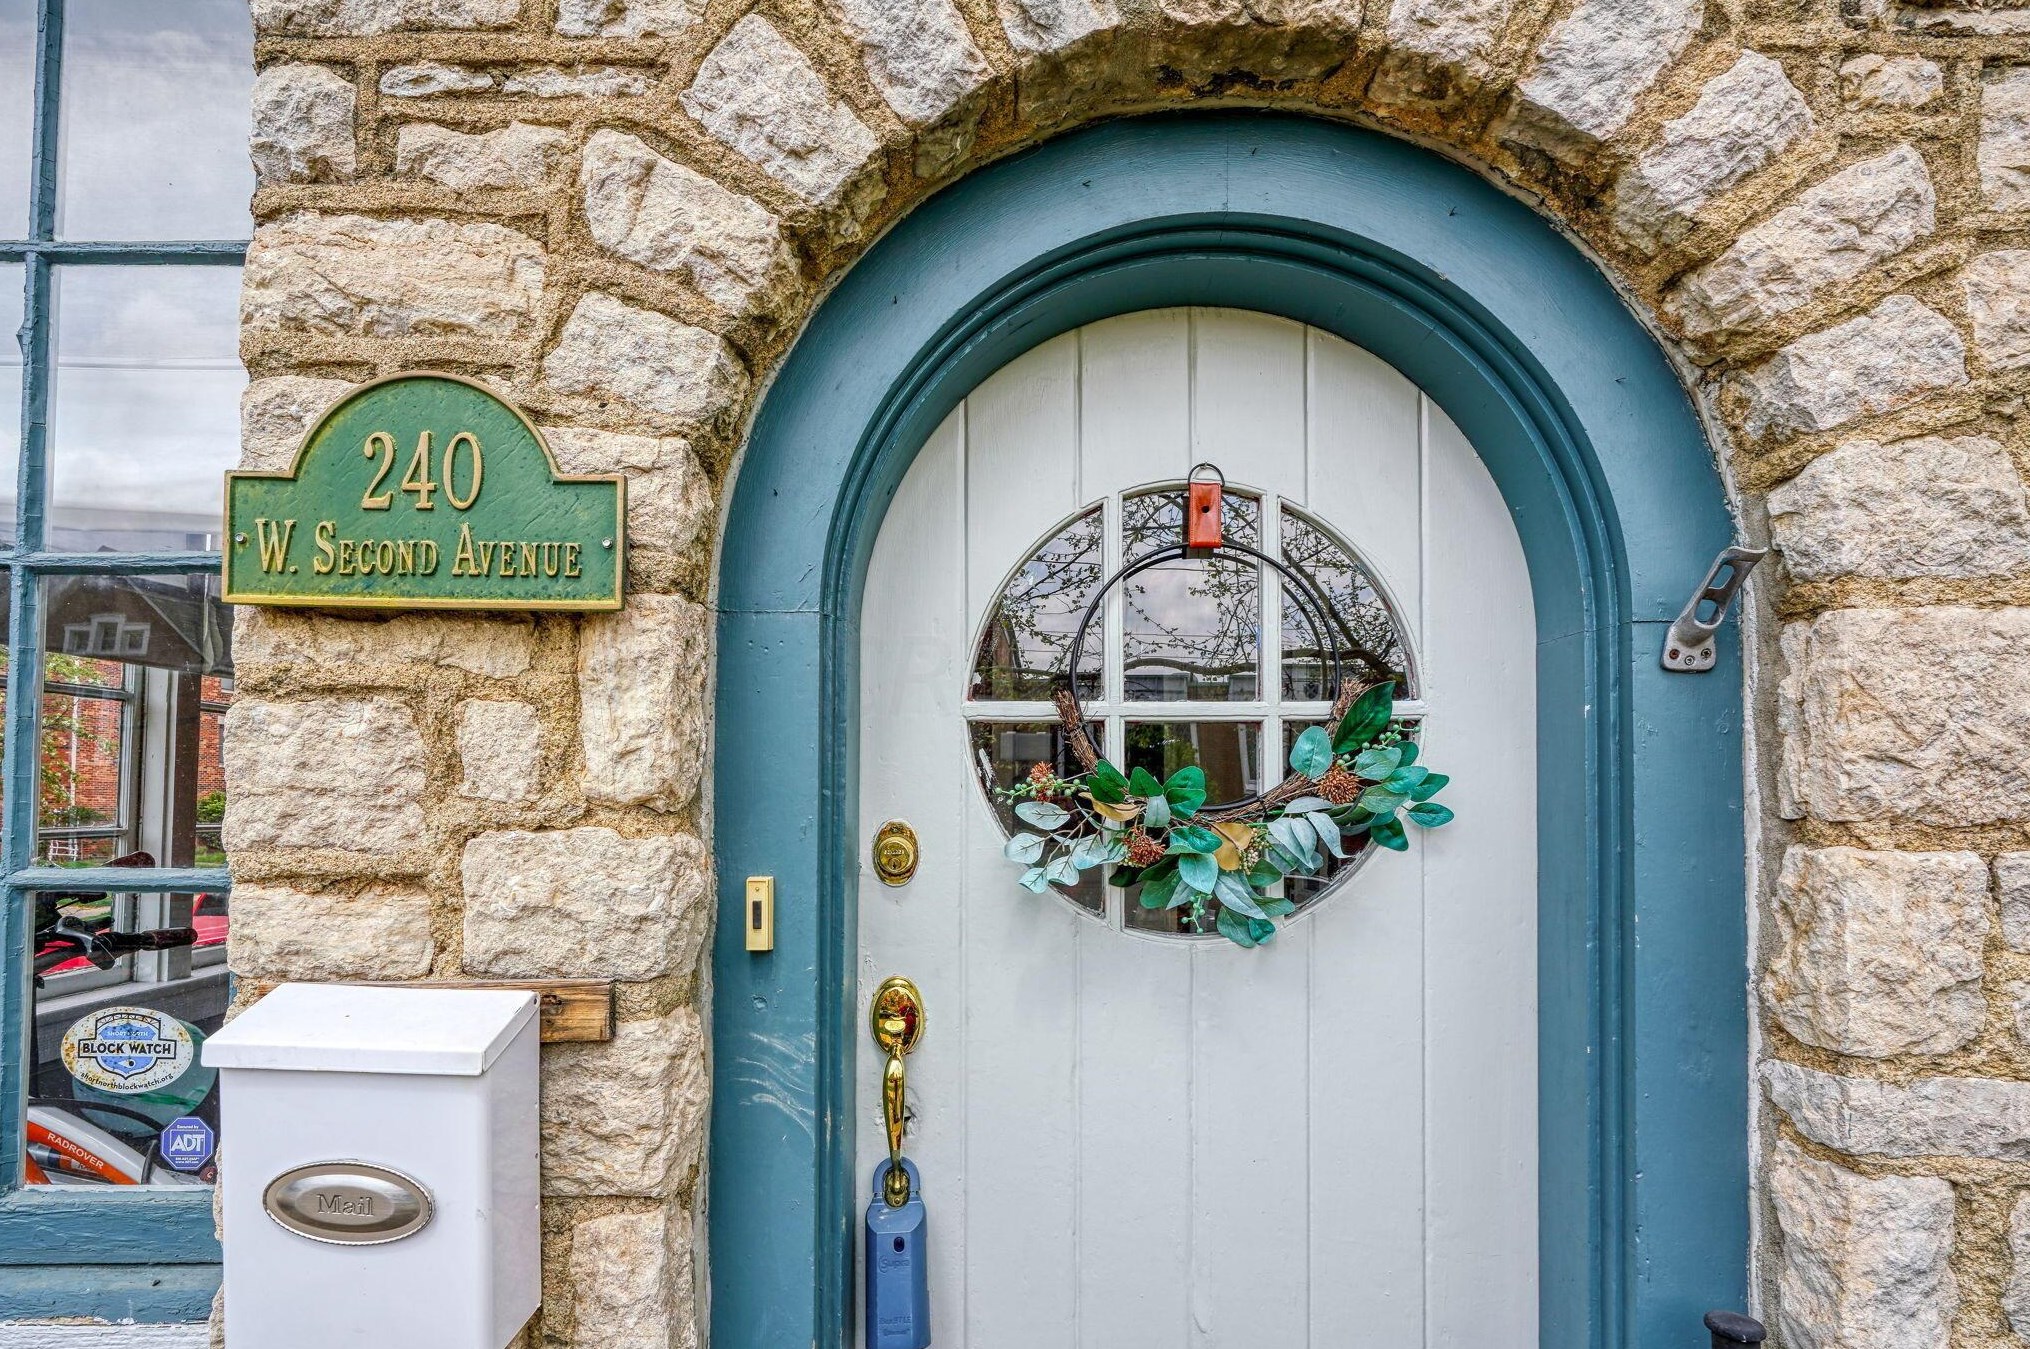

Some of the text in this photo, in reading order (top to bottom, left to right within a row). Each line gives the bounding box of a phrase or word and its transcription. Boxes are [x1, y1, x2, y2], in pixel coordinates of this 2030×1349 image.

[361, 431, 484, 511] 240
[255, 519, 583, 578] W. SECOND AVENUE
[82, 1043, 171, 1055] BLOCK WATCH
[80, 1073, 174, 1090] shortnorthblockwatch.org
[47, 1132, 104, 1169] RADROVER
[171, 1134, 205, 1152] ADT
[316, 1194, 374, 1217] Mail
